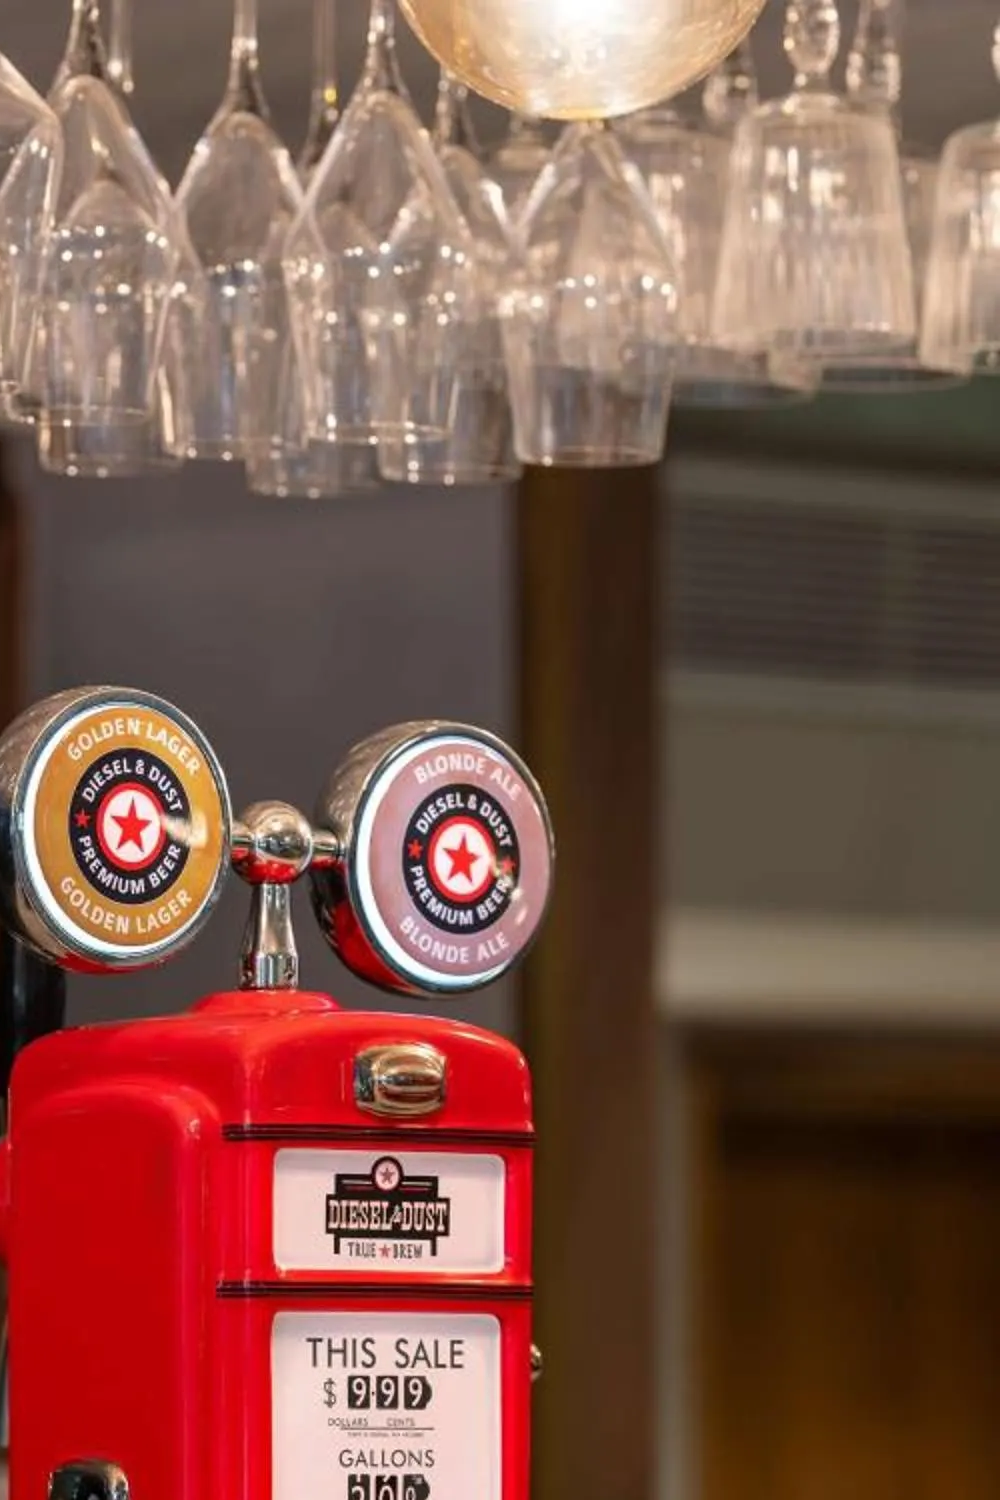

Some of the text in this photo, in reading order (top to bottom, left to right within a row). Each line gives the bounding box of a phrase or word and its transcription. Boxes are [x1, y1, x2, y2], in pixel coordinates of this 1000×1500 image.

[67, 718, 201, 775] GOLDEN LAGER
[82, 758, 183, 811] DIESEL & DUST
[414, 753, 522, 801] BLONDE ALE
[416, 792, 513, 847] DIESEL & DUST
[79, 836, 181, 894] PREMIUM BEER
[61, 877, 192, 935] GOLDEN LAGER
[410, 865, 511, 925] PREMIUM BEER
[400, 916, 510, 964] BLONDE ALE
[401, 1201, 447, 1232] DUST
[347, 1242, 423, 1259] TRUE BREW
[306, 1337, 464, 1368] THIS SALE
[328, 1417, 415, 1427] DOLLARS CENTS
[339, 1448, 435, 1468] GALLONS
